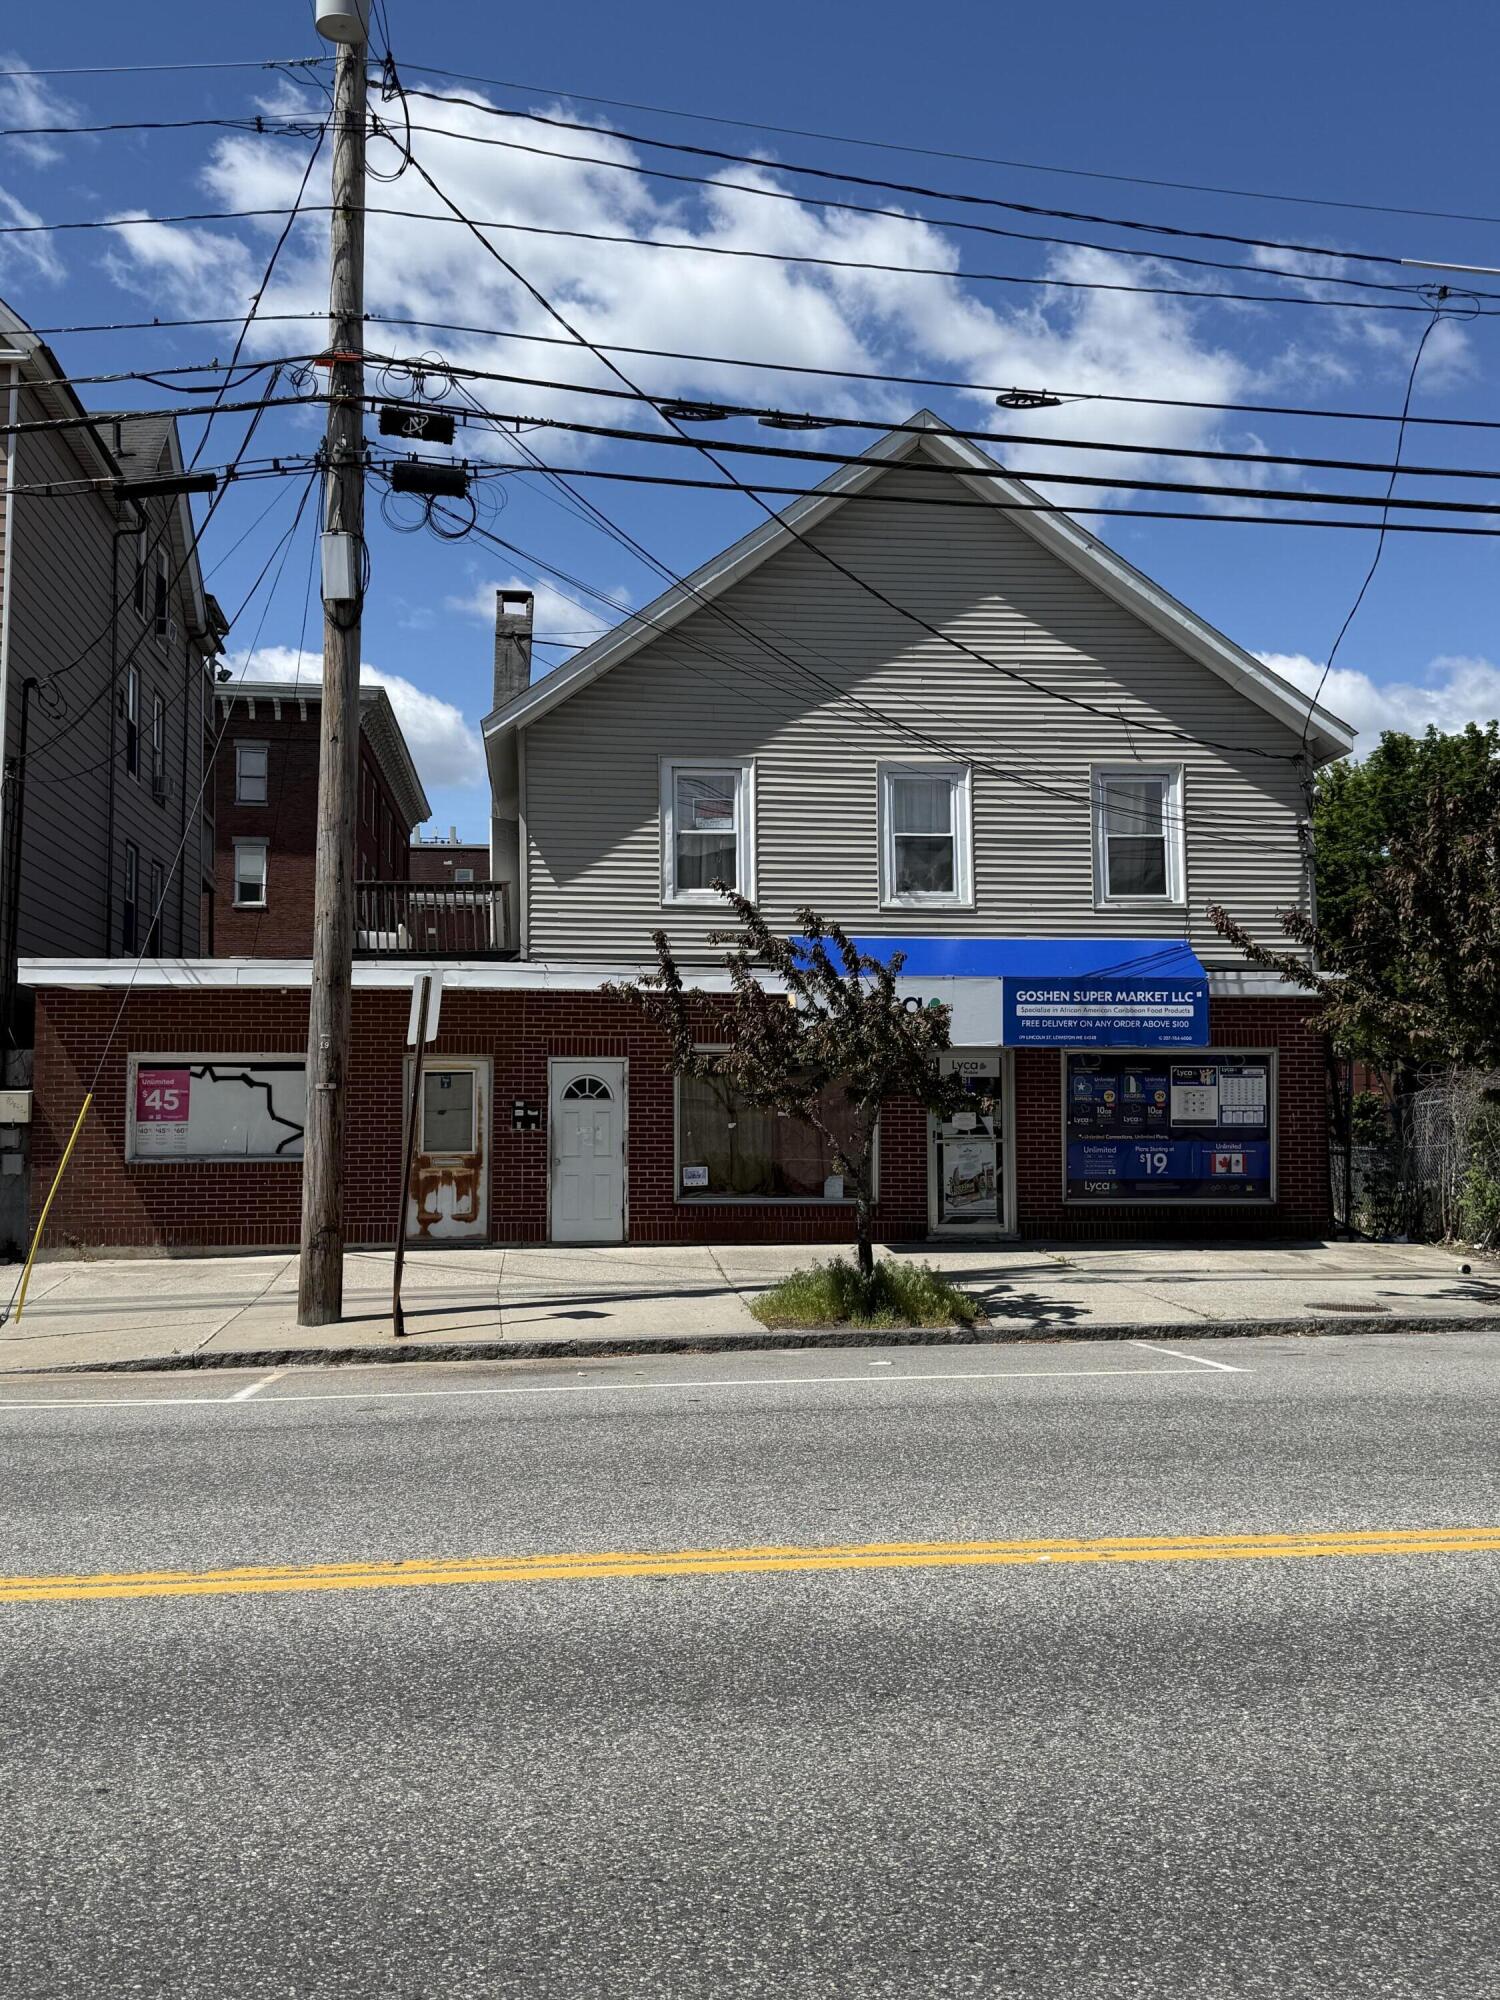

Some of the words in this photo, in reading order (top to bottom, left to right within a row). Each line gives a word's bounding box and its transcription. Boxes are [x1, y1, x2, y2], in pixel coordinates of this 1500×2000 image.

[1016, 990, 1070, 1002] GOSHEN
[1073, 991, 1113, 1002] SUPER
[1115, 991, 1169, 1002] MARKET
[1171, 991, 1194, 1003] LLC
[1021, 1006, 1051, 1014] Specialize
[1052, 1006, 1058, 1014] in
[1021, 1020, 1040, 1028] FREE
[1041, 1020, 1078, 1028] DELIVERY
[1079, 1020, 1093, 1028] ON
[1094, 1020, 1112, 1028] ANY
[1113, 1020, 1141, 1028] ORDER
[1142, 1020, 1170, 1028] ABOVE
[1172, 1020, 1189, 1028] $100
[952, 1059, 978, 1073] Lyca
[1176, 1069, 1193, 1077] Lyca
[142, 1088, 180, 1111] $45
[1073, 1116, 1089, 1124] Lyca
[1123, 1115, 1139, 1123] Lyca
[1083, 1145, 1117, 1154] Unlimited
[1139, 1153, 1166, 1174] $19
[1084, 1180, 1110, 1193] Lyca
